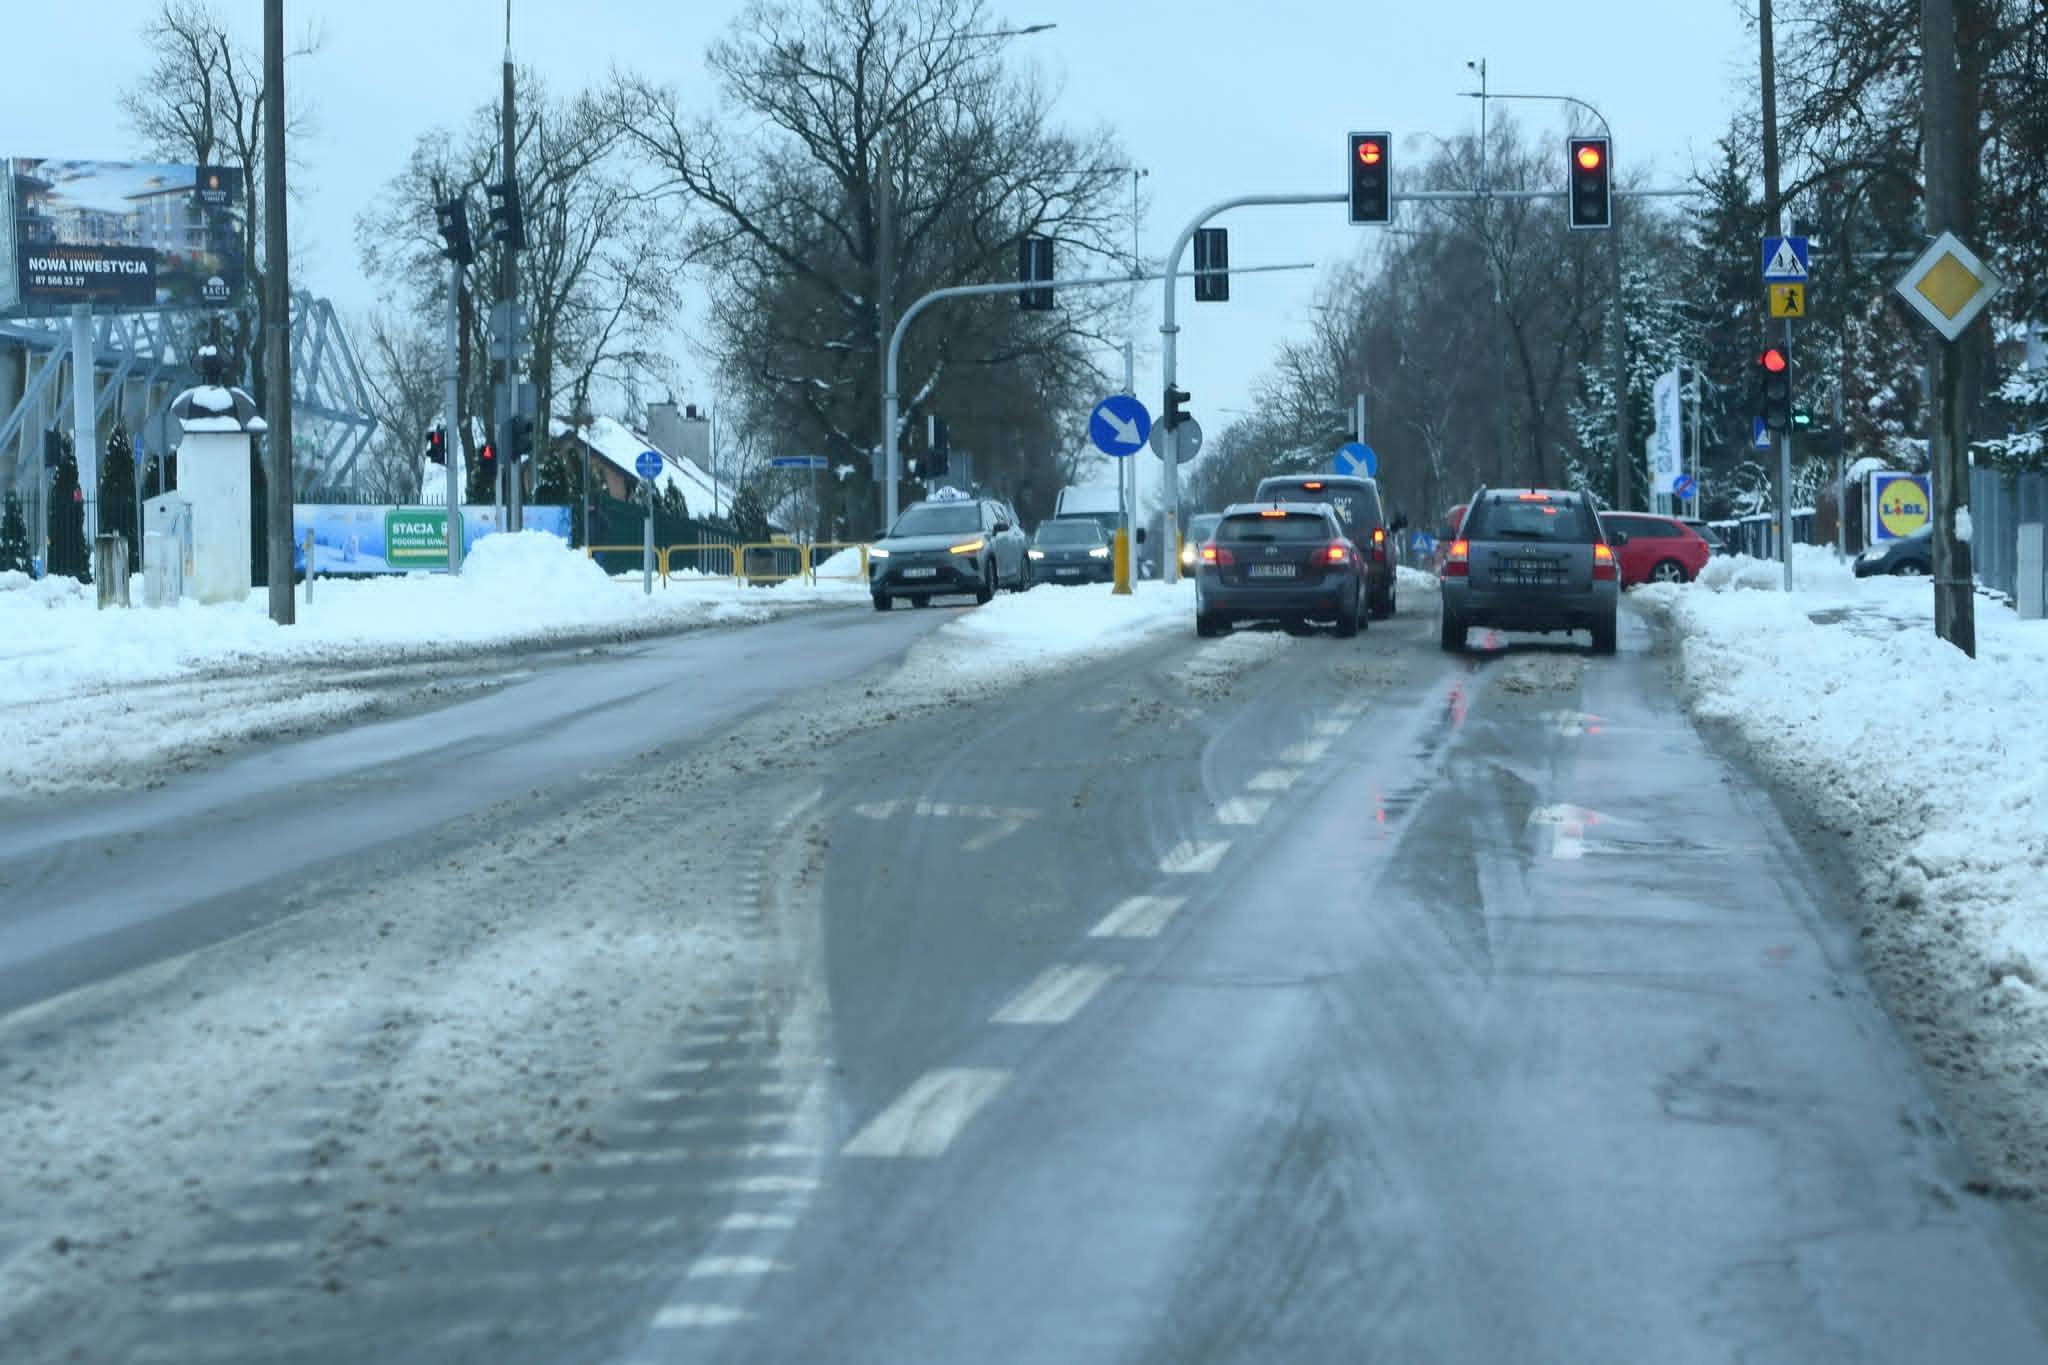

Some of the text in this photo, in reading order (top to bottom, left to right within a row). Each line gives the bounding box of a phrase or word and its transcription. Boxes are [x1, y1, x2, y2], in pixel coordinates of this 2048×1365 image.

[28, 257, 149, 274] NOWA INWESTYCJA
[392, 522, 435, 535] STACJA
